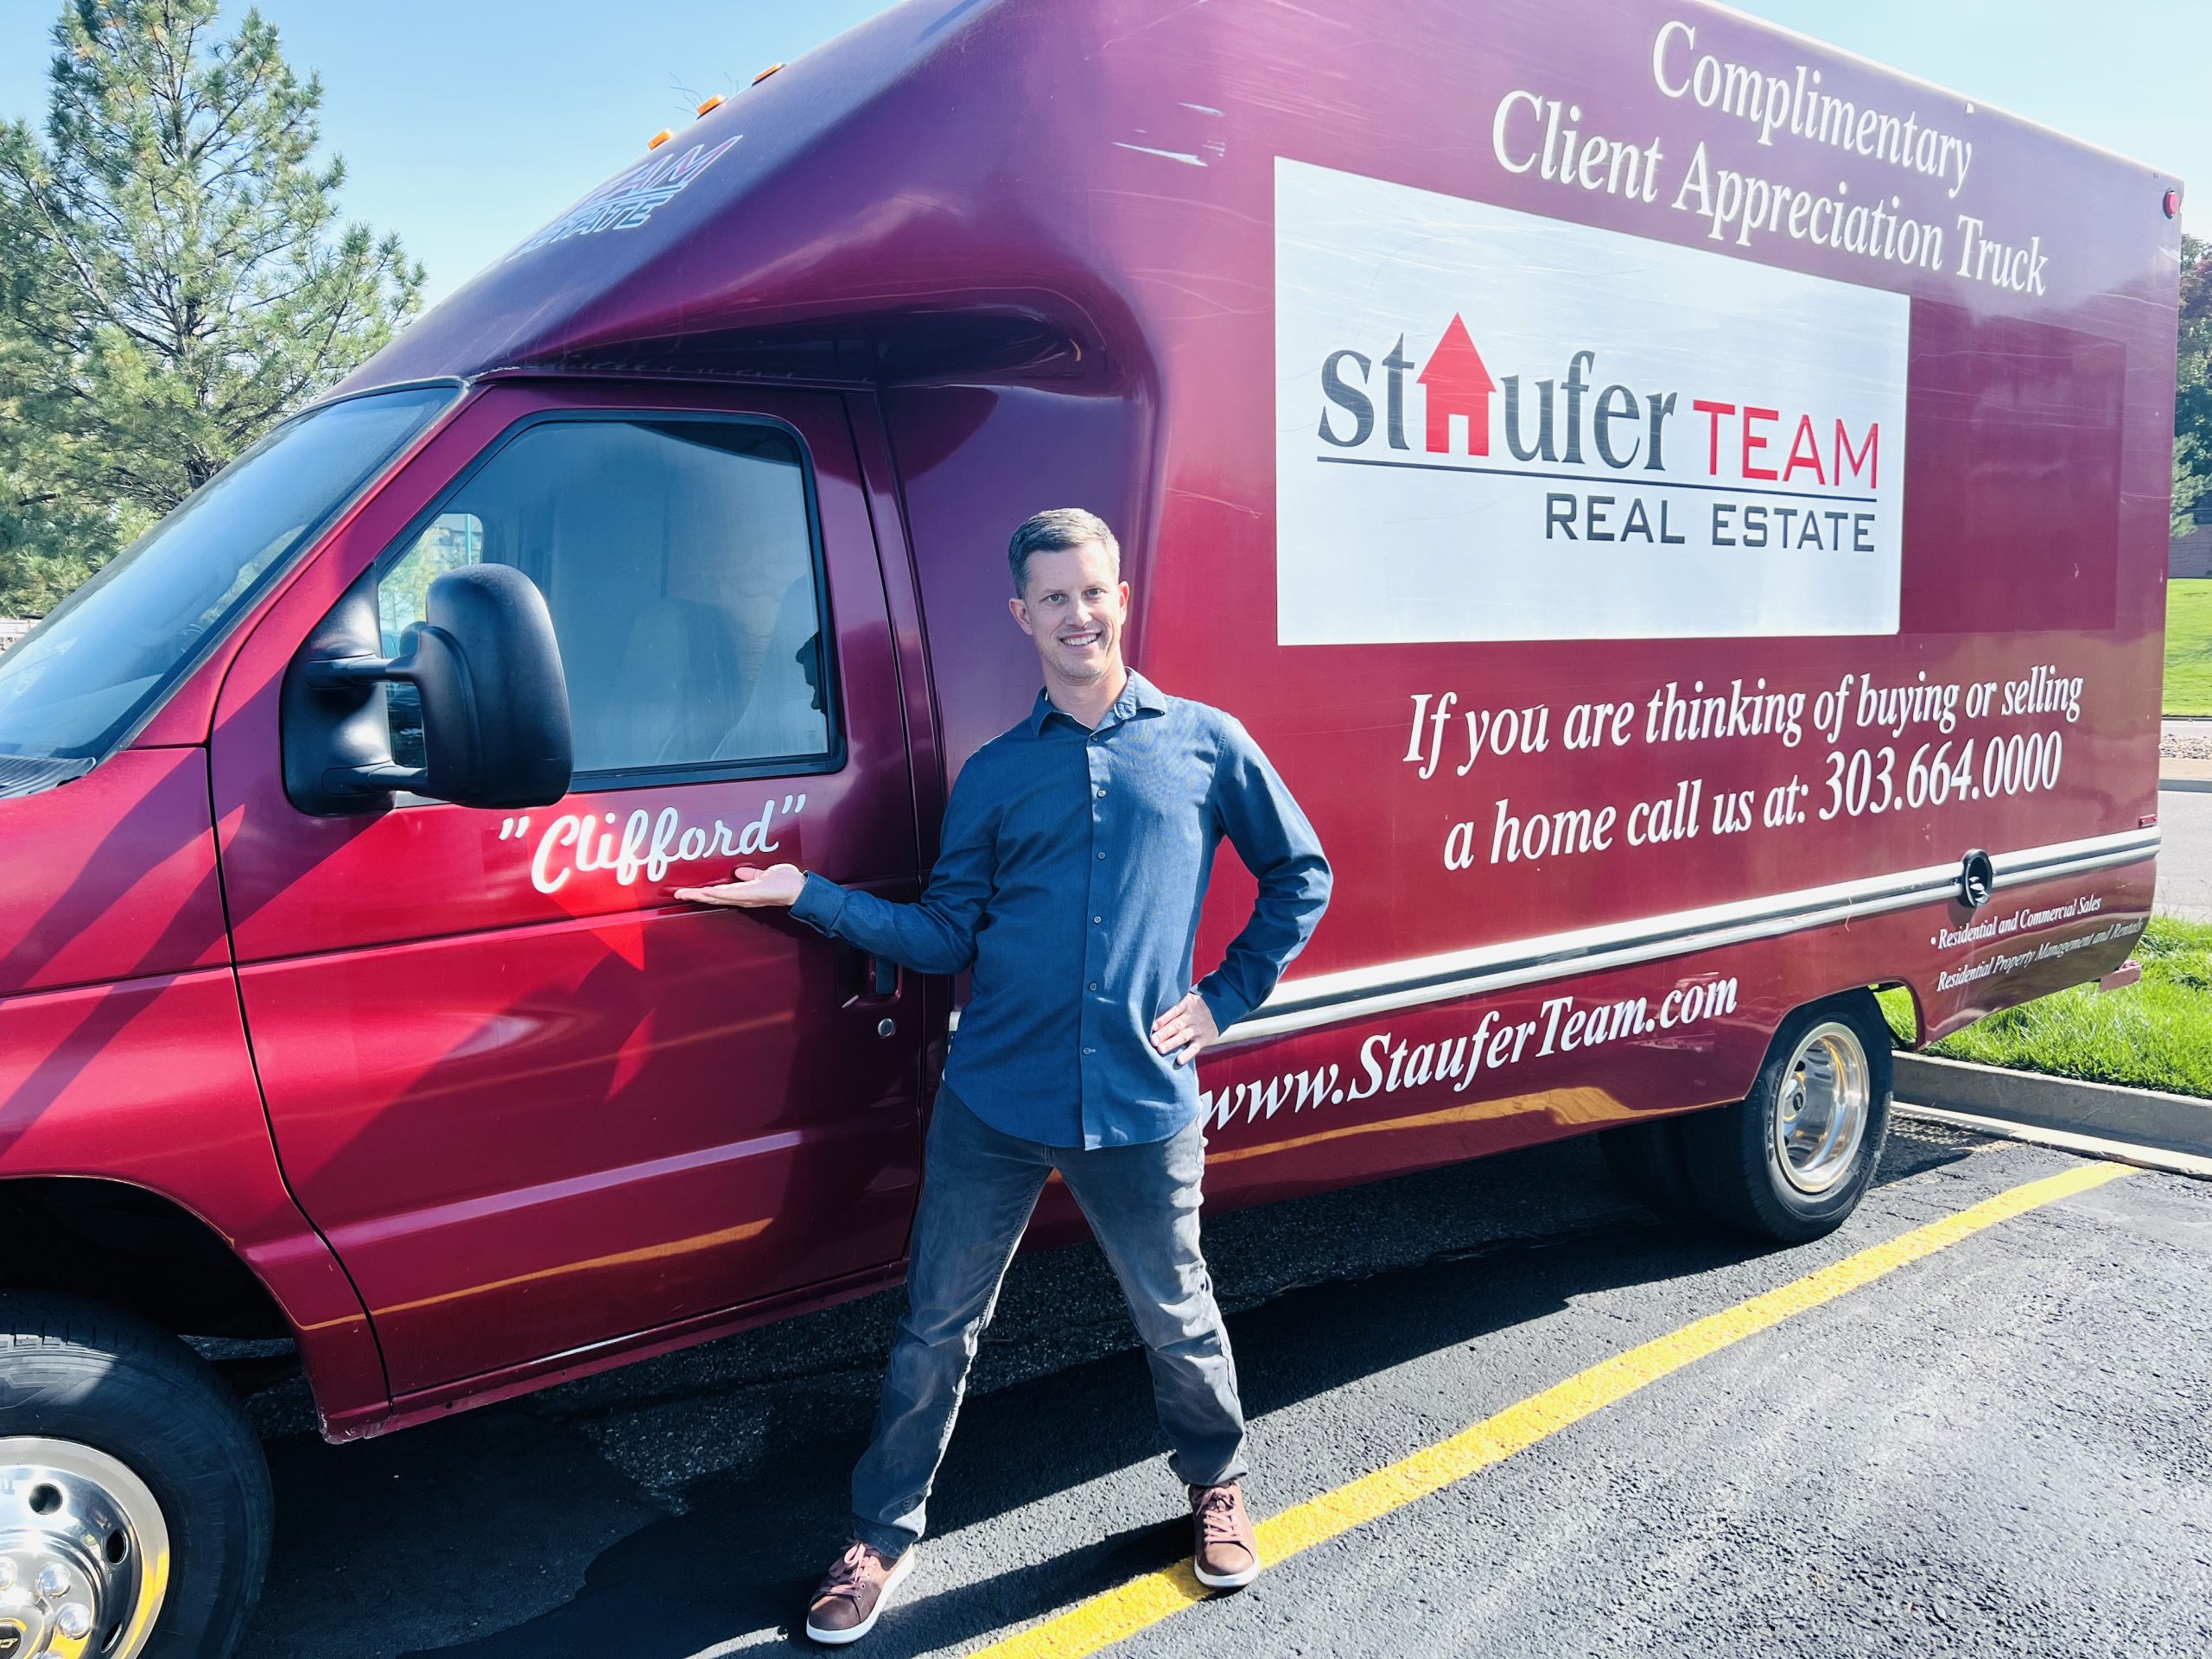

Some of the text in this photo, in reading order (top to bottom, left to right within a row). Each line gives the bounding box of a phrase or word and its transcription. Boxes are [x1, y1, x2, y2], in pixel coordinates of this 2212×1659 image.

[1652, 20, 1973, 199] Complimentary
[1492, 90, 2050, 296] Client Appreciation Truck
[1693, 399, 1879, 489] TEAM
[1546, 492, 1876, 553] REAL ESTATE
[1402, 664, 2084, 779] If you are thinking of buying or selling
[1443, 730, 2063, 871] a home call us at: 303.664.0000
[1936, 956, 1995, 992] Residential
[1993, 949, 2036, 975] Property
[2034, 932, 2094, 958] Management
[2092, 924, 2113, 944] and
[1937, 893, 2102, 950] Residential and Commercial Sales
[1199, 971, 1738, 1131] www.StauferTeam.com
